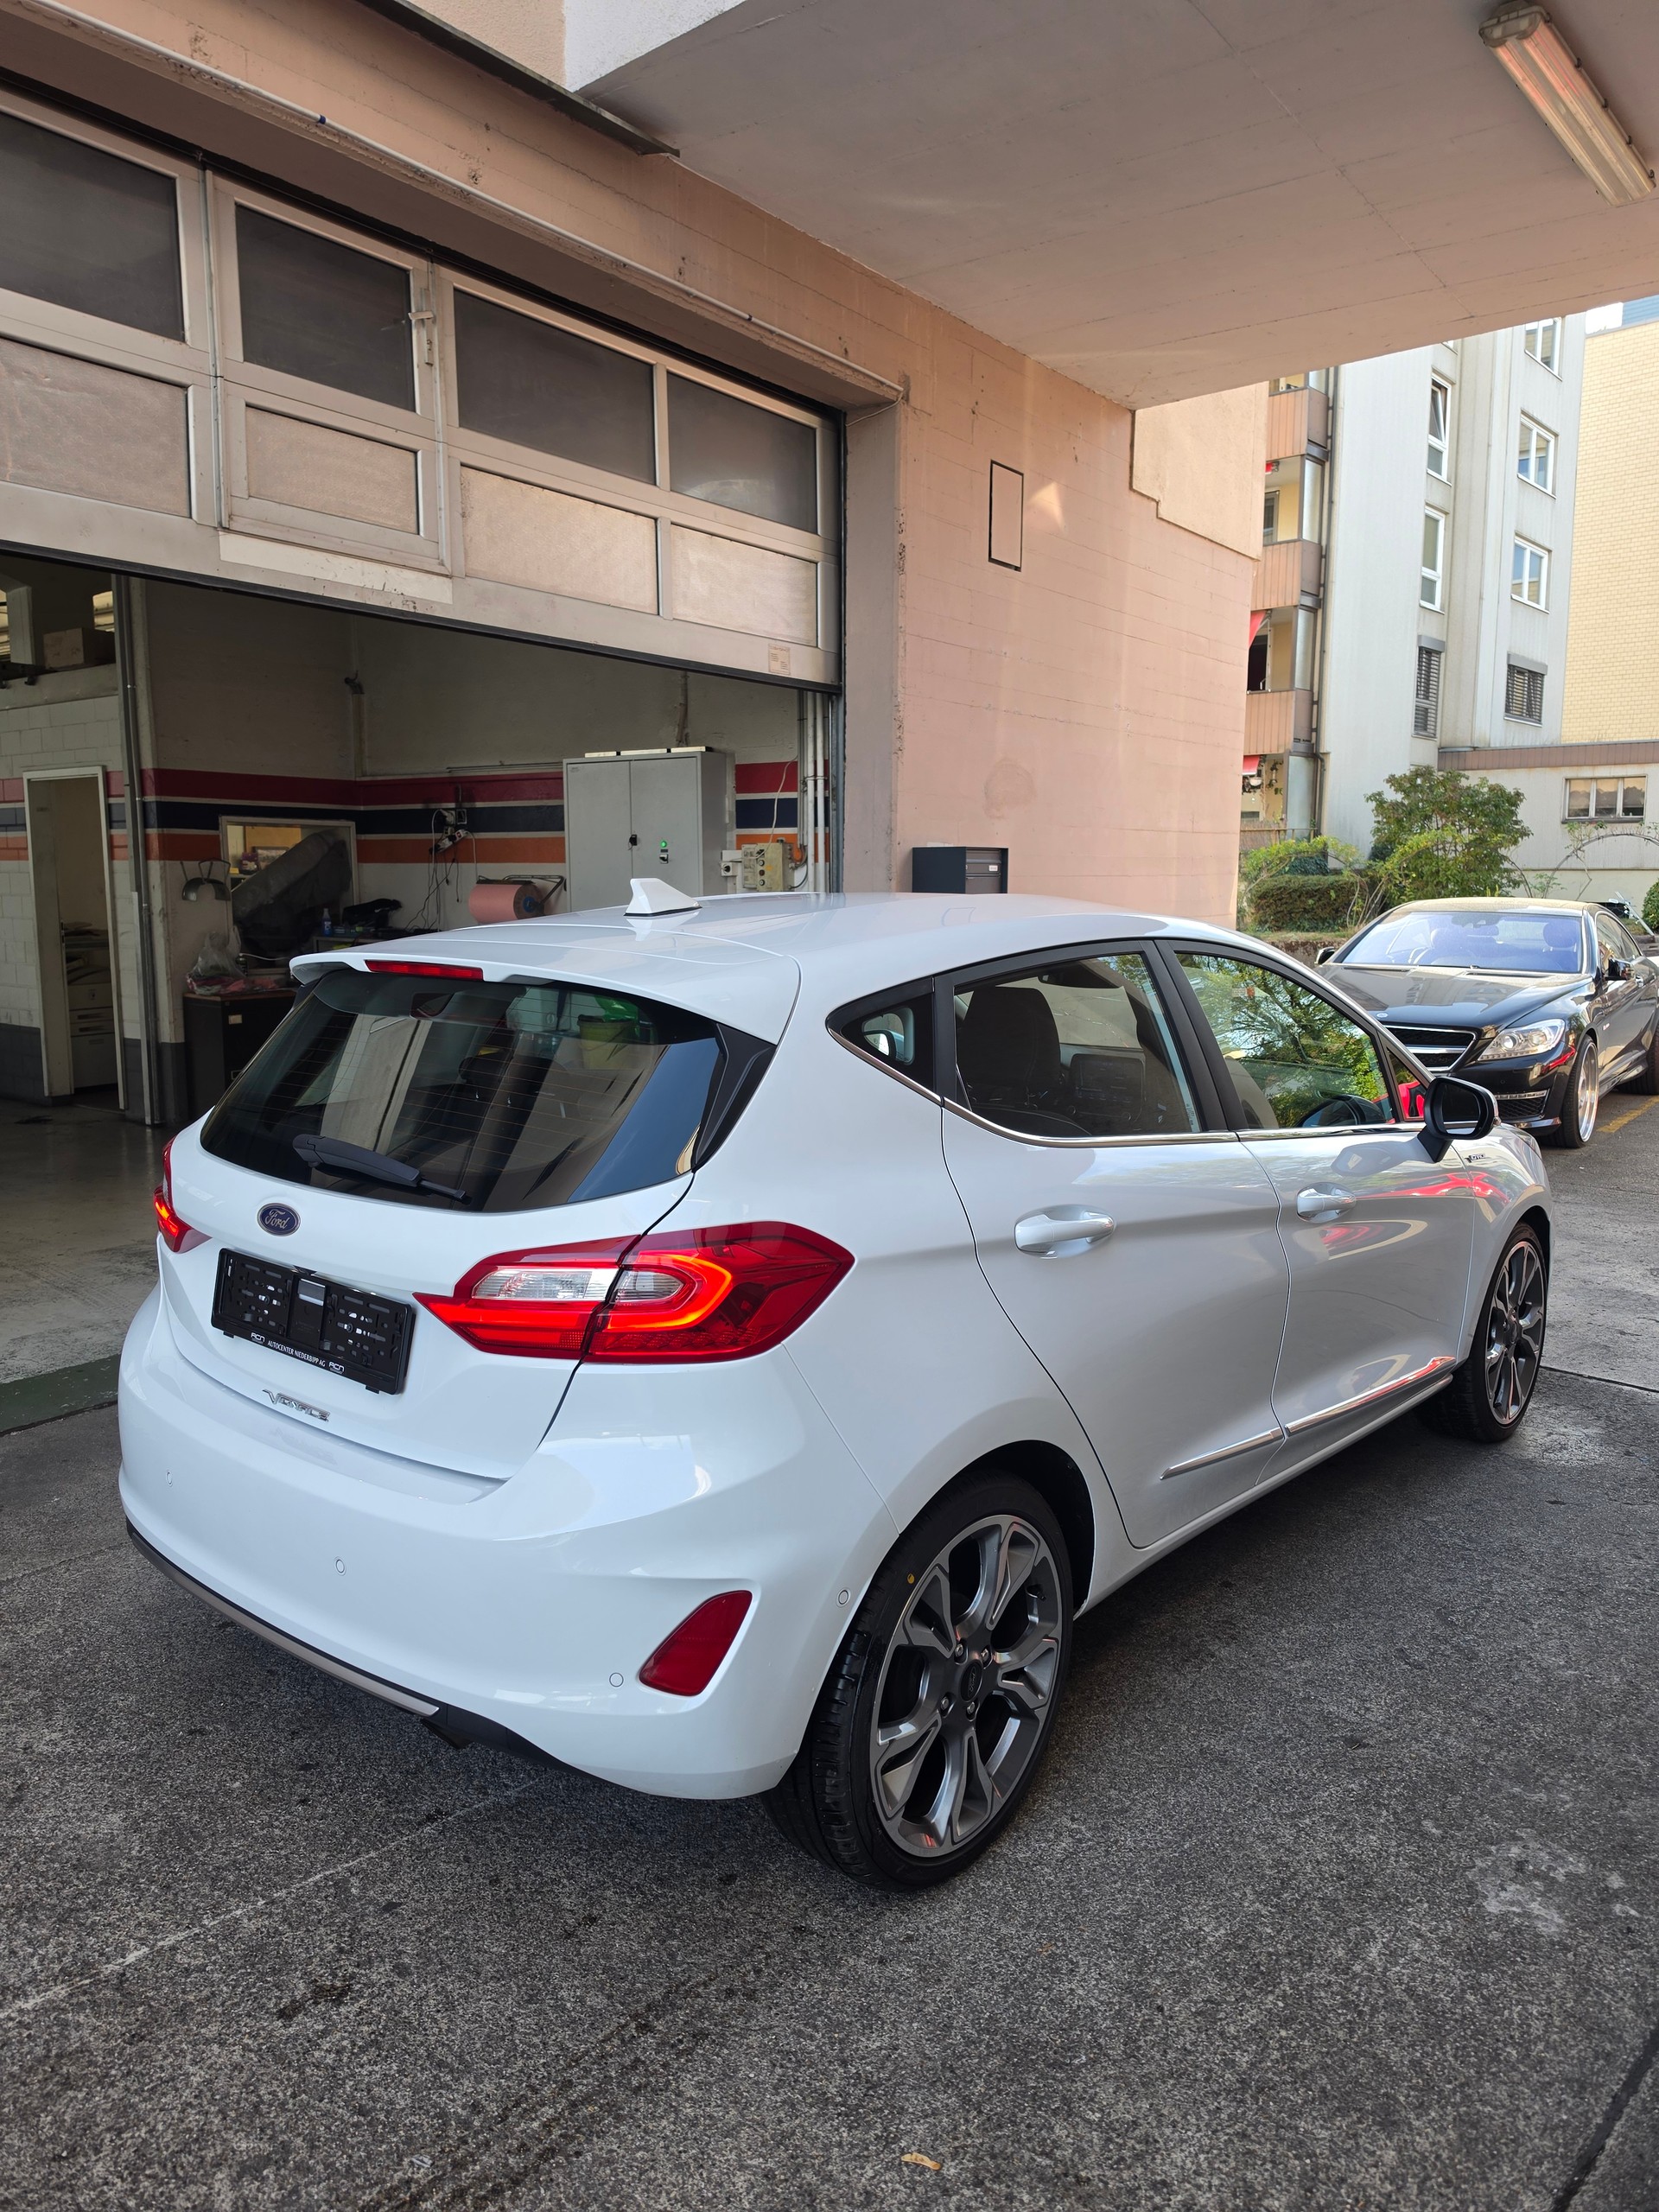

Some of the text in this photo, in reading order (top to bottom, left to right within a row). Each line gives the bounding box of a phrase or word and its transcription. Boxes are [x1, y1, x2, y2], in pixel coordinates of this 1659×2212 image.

[264, 1209, 290, 1229] Ford
[267, 1340, 294, 1355] AUTOCENTER
[294, 1351, 319, 1363] NIEDERBIPP
